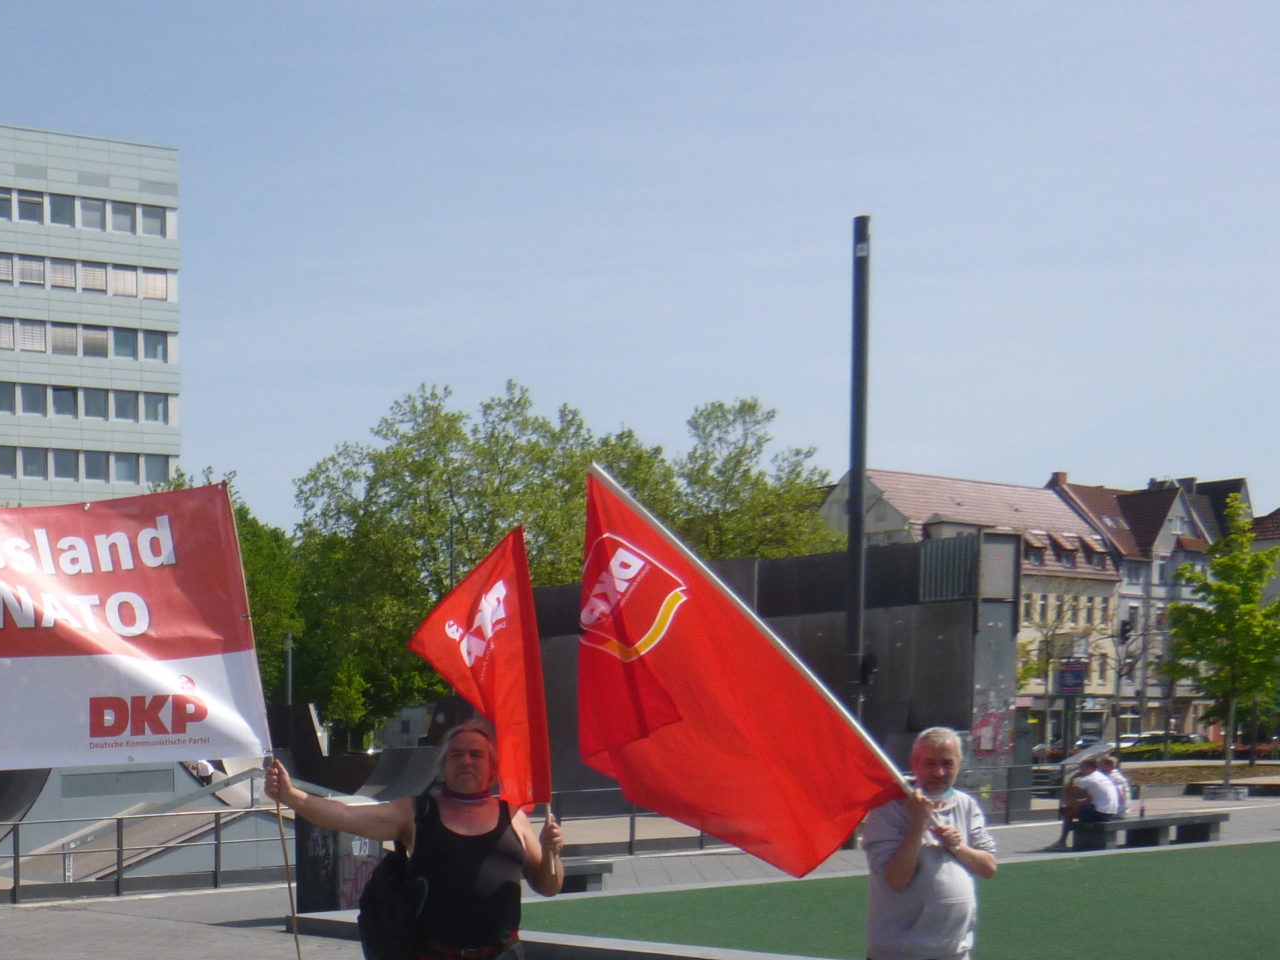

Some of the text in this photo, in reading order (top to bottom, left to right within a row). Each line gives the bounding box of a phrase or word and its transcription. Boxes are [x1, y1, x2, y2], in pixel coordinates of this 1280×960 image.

[89, 694, 209, 738] DKP
[89, 737, 210, 750] Deutsche Kommunistische Partei
